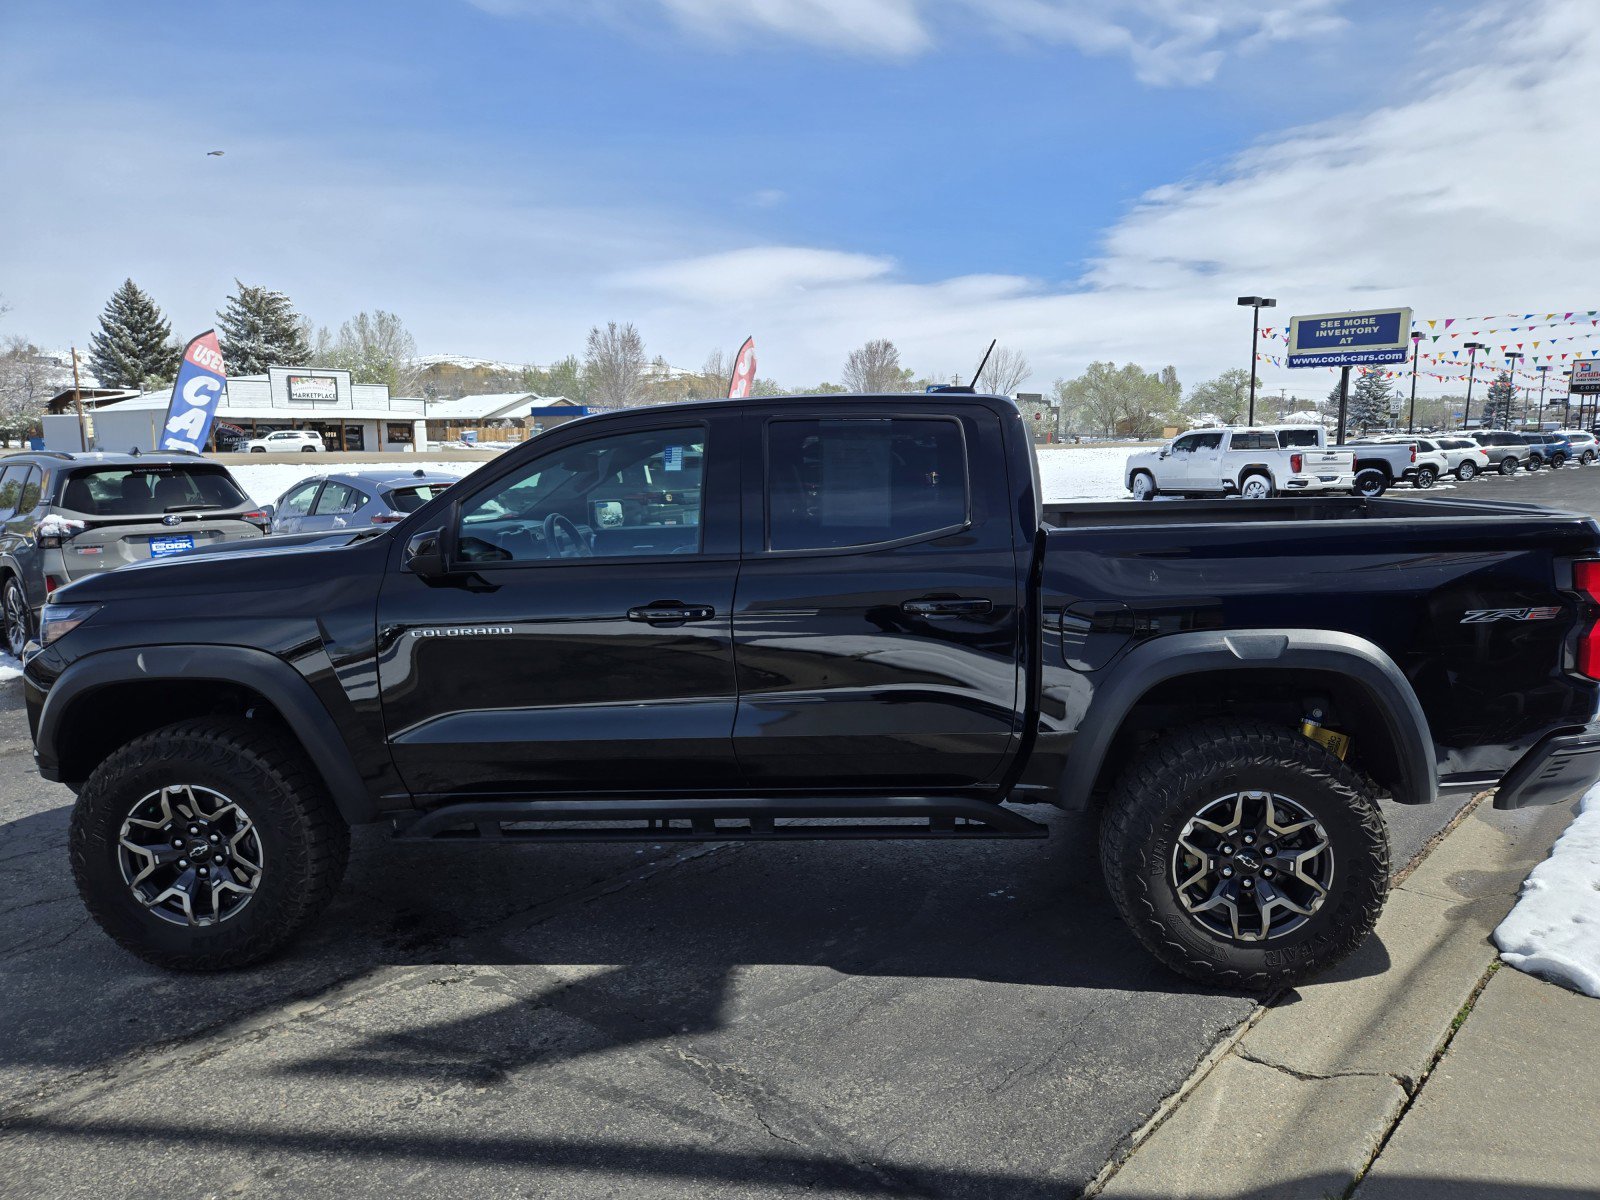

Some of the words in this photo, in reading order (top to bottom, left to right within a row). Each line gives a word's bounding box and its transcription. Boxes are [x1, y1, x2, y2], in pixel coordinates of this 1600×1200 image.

[1344, 317, 1376, 326] MORE
[1316, 326, 1380, 337] INVENTORY
[1339, 337, 1353, 345] AT
[1292, 353, 1402, 364] www.cook-cars.com
[1460, 606, 1562, 624] ZR2
[411, 627, 513, 638] COLORADO
